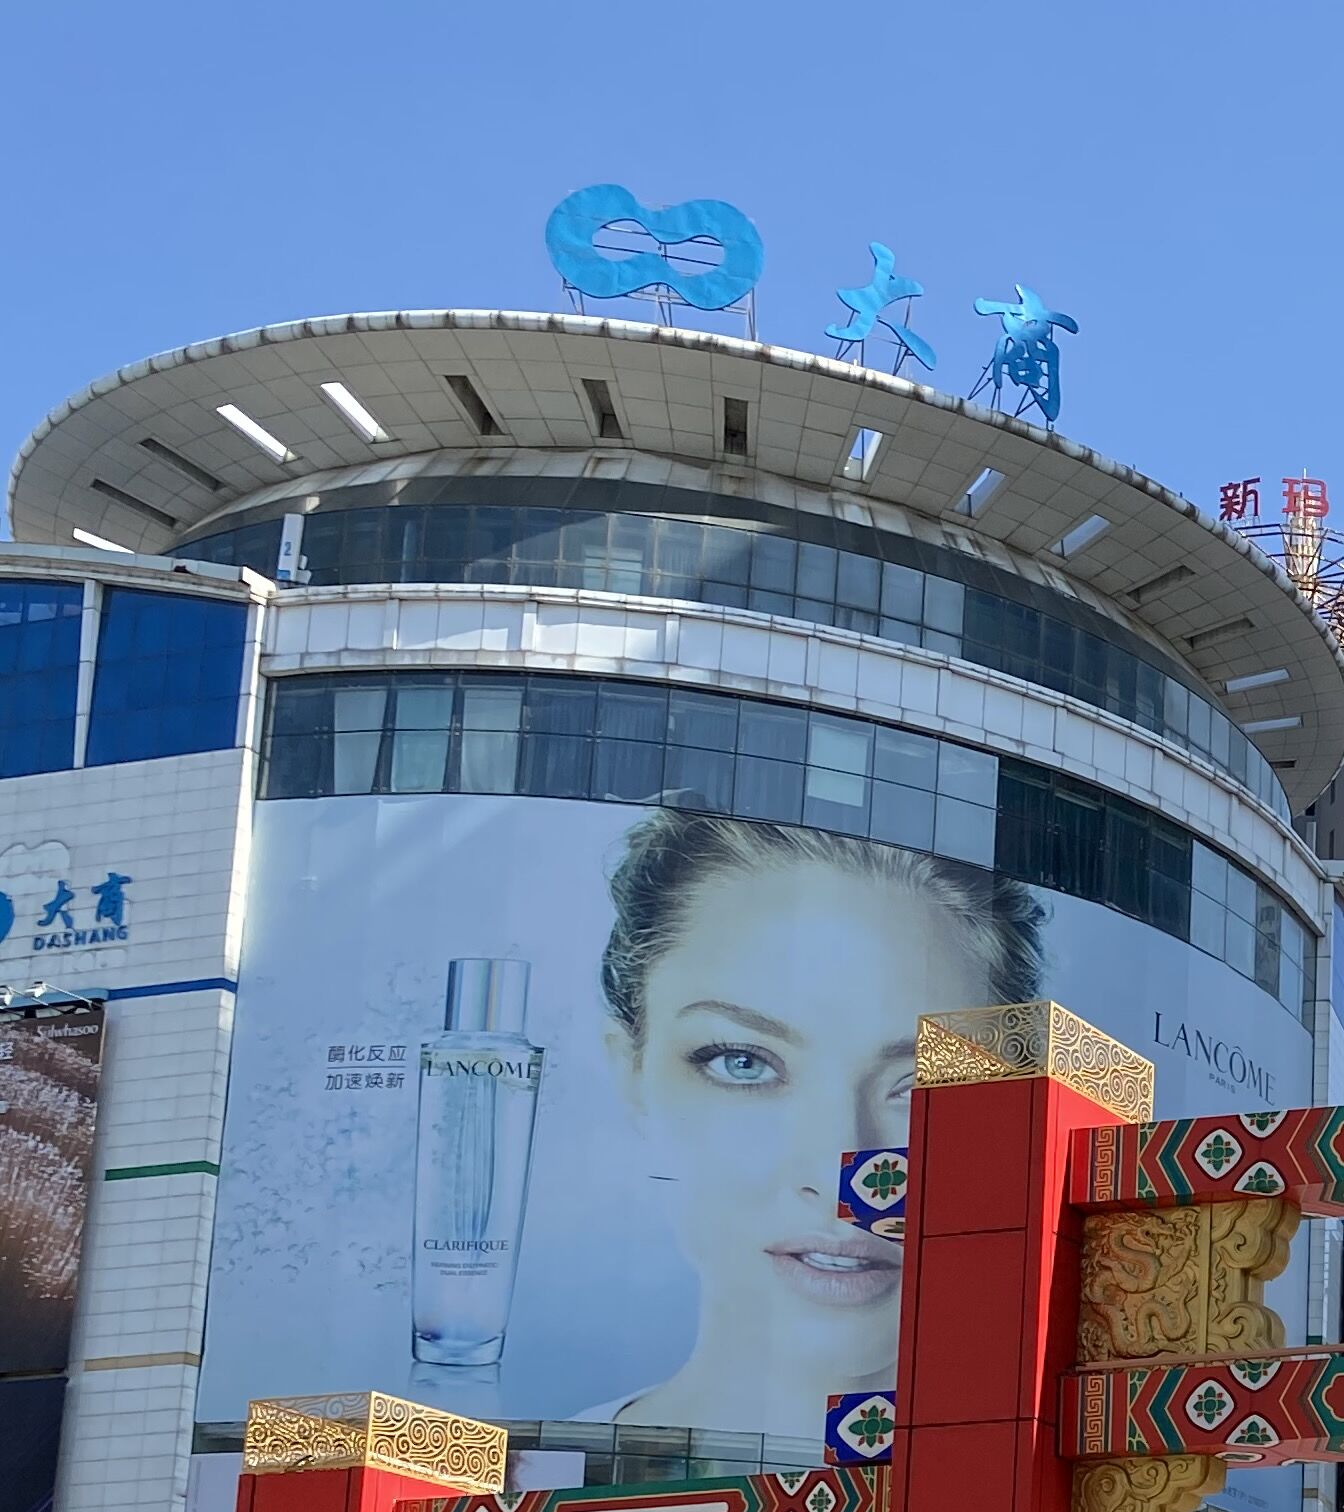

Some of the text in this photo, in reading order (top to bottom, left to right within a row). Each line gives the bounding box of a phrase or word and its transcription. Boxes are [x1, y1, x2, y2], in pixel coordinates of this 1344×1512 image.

[825, 242, 1079, 421] 大商
[37, 872, 133, 929] 大商
[33, 925, 129, 951] DASHANG
[327, 1045, 407, 1063] 酶化反应
[1154, 1011, 1276, 1106] LANCÔME
[324, 1072, 406, 1091] 加速焕新
[1208, 1072, 1237, 1095] PARIS
[423, 1239, 510, 1254] CLARIFIQUE
